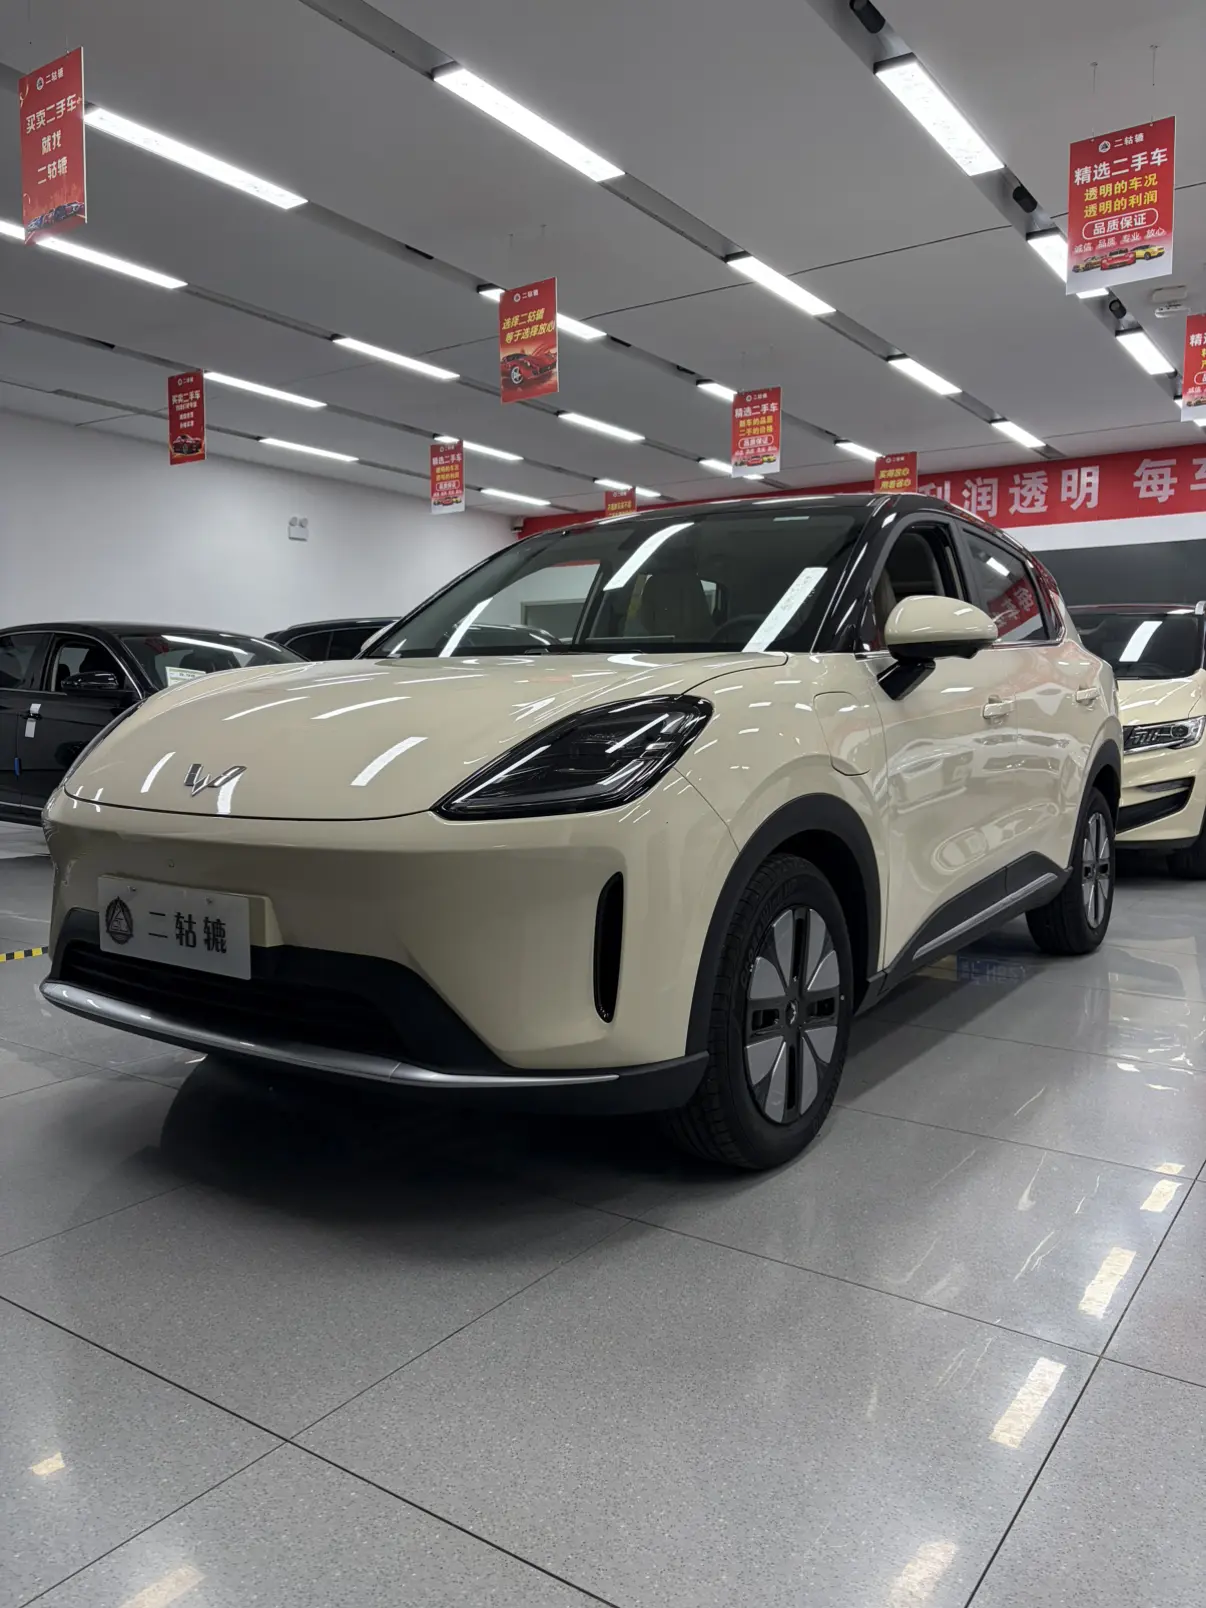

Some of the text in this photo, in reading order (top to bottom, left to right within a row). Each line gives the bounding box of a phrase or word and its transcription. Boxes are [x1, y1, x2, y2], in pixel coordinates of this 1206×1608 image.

[26, 93, 77, 134] 买卖二手车
[41, 130, 62, 155] 就找
[1114, 133, 1144, 147] 二轱辘
[38, 156, 68, 184] 二轱辘
[1074, 148, 1168, 186] 精选二手车
[1084, 173, 1158, 202] 透明的车况
[1084, 190, 1158, 218] 透明的利润
[1093, 213, 1147, 236] 品质保证
[1121, 232, 1141, 243] 专业
[1145, 227, 1167, 238] 放心
[502, 307, 545, 330] 选择二轱辘
[505, 320, 555, 344] 等于选择放心
[1189, 332, 1206, 347] 精
[735, 402, 778, 418] 精选二手车
[148, 911, 227, 953] 二轱辘
